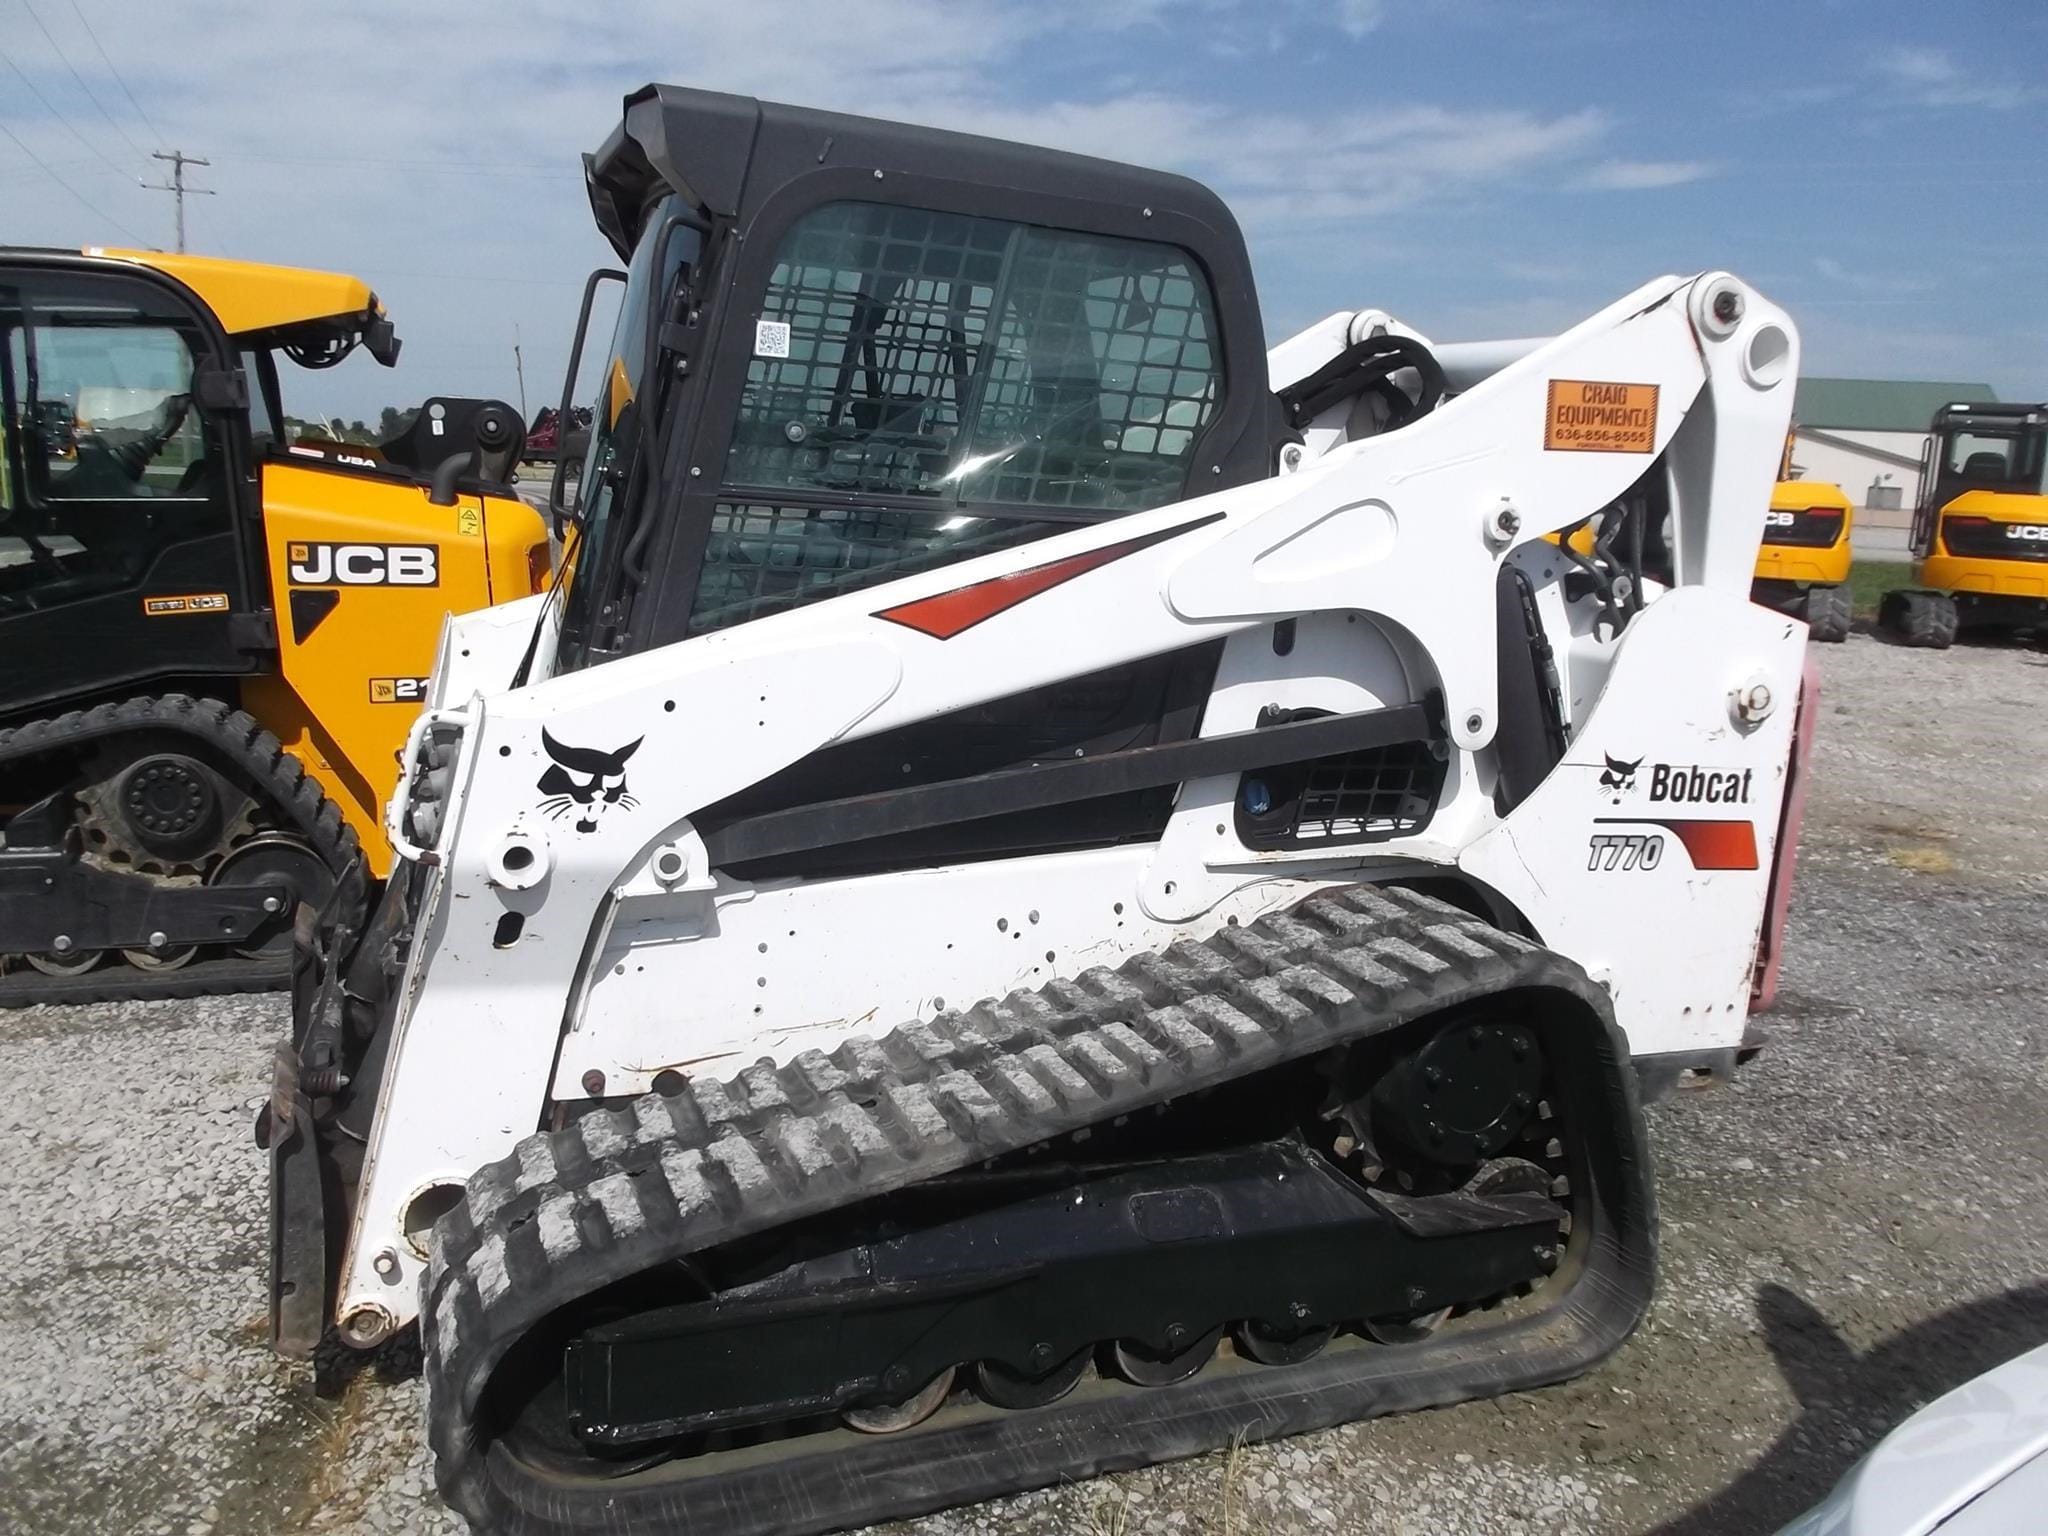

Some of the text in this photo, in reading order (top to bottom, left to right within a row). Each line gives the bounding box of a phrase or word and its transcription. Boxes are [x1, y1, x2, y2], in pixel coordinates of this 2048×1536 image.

[1582, 383, 1628, 405] CRAIG
[1555, 428, 1647, 443] 636-856-8555
[1765, 511, 1795, 526] CB
[291, 544, 437, 584] JCB
[1649, 763, 1753, 804] Bobcat
[1587, 834, 1665, 871] T770
